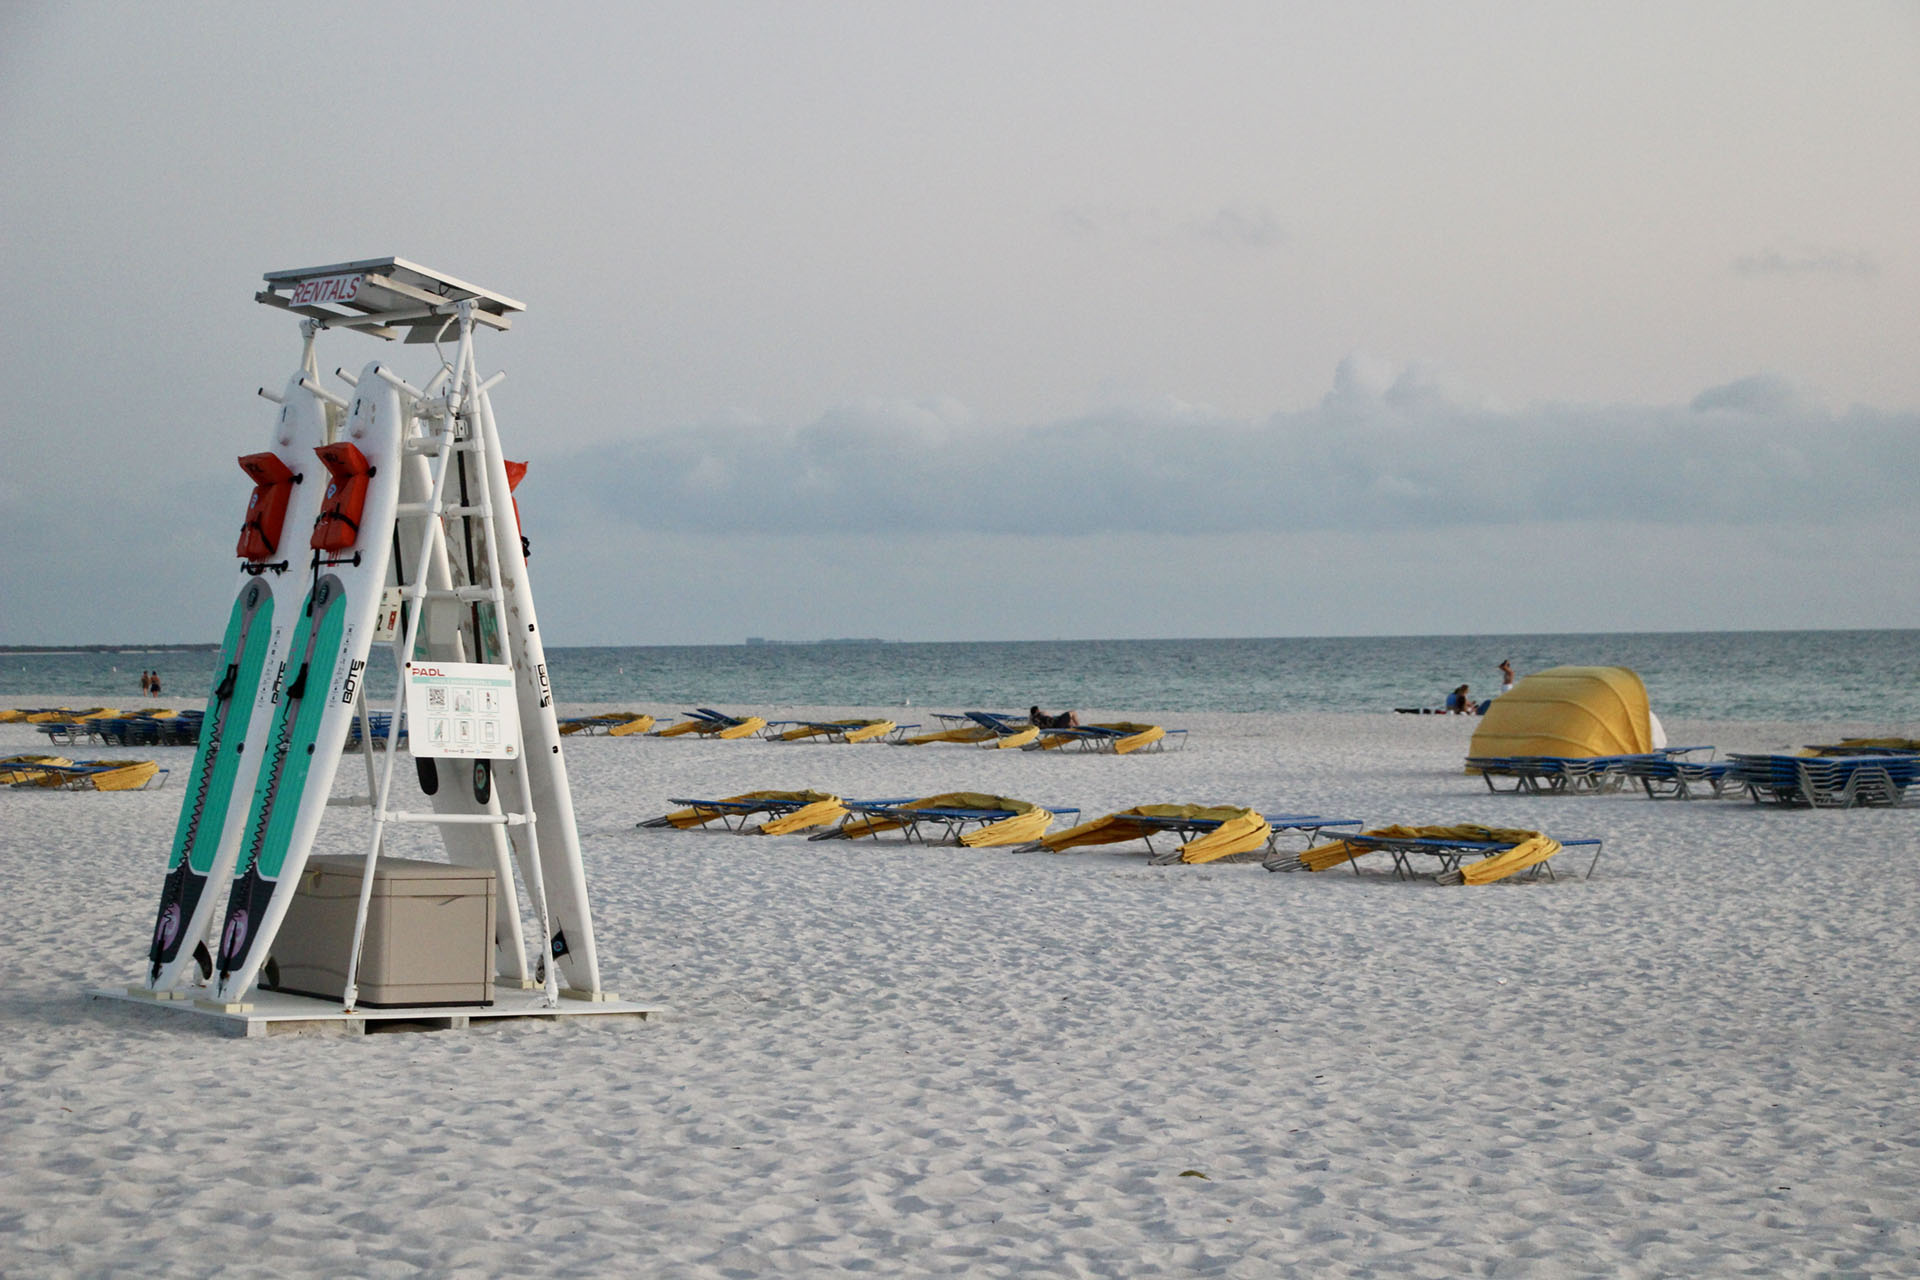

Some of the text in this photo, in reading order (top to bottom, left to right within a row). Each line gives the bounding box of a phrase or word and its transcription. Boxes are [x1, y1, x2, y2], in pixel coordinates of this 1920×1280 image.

[289, 277, 360, 304] RENTALS
[342, 658, 363, 705] BOTE
[411, 667, 446, 678] PADL
[538, 663, 552, 708] BOTE
